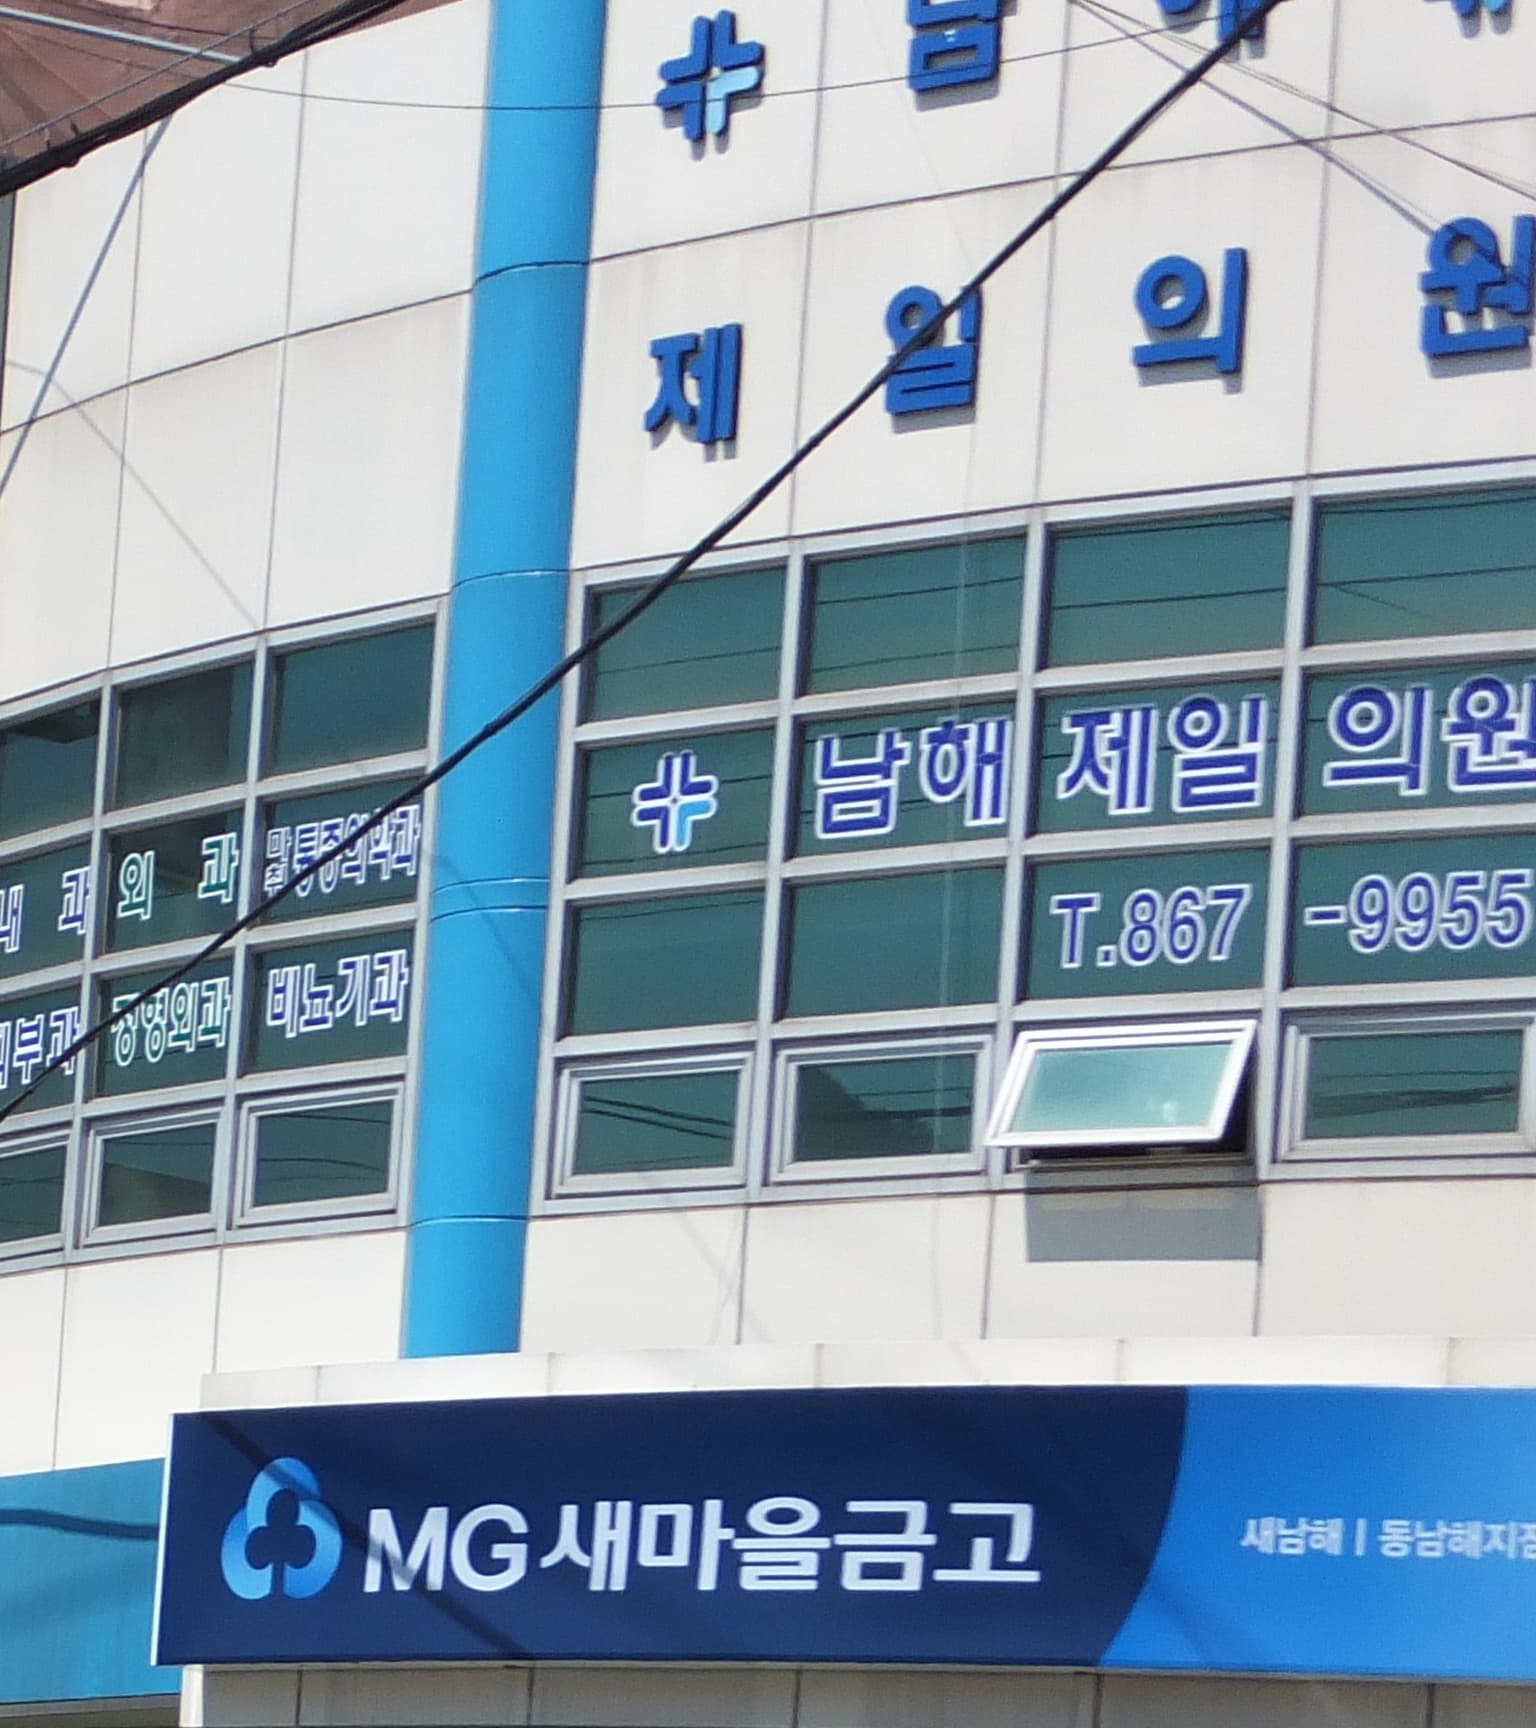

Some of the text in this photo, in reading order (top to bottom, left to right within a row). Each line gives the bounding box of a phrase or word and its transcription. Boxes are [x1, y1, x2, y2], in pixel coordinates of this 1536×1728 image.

[813, 674, 1536, 839] 남해 제일 의원
[266, 949, 409, 1038] 비뇨기과
[1239, 1515, 1345, 1557] 새남해
